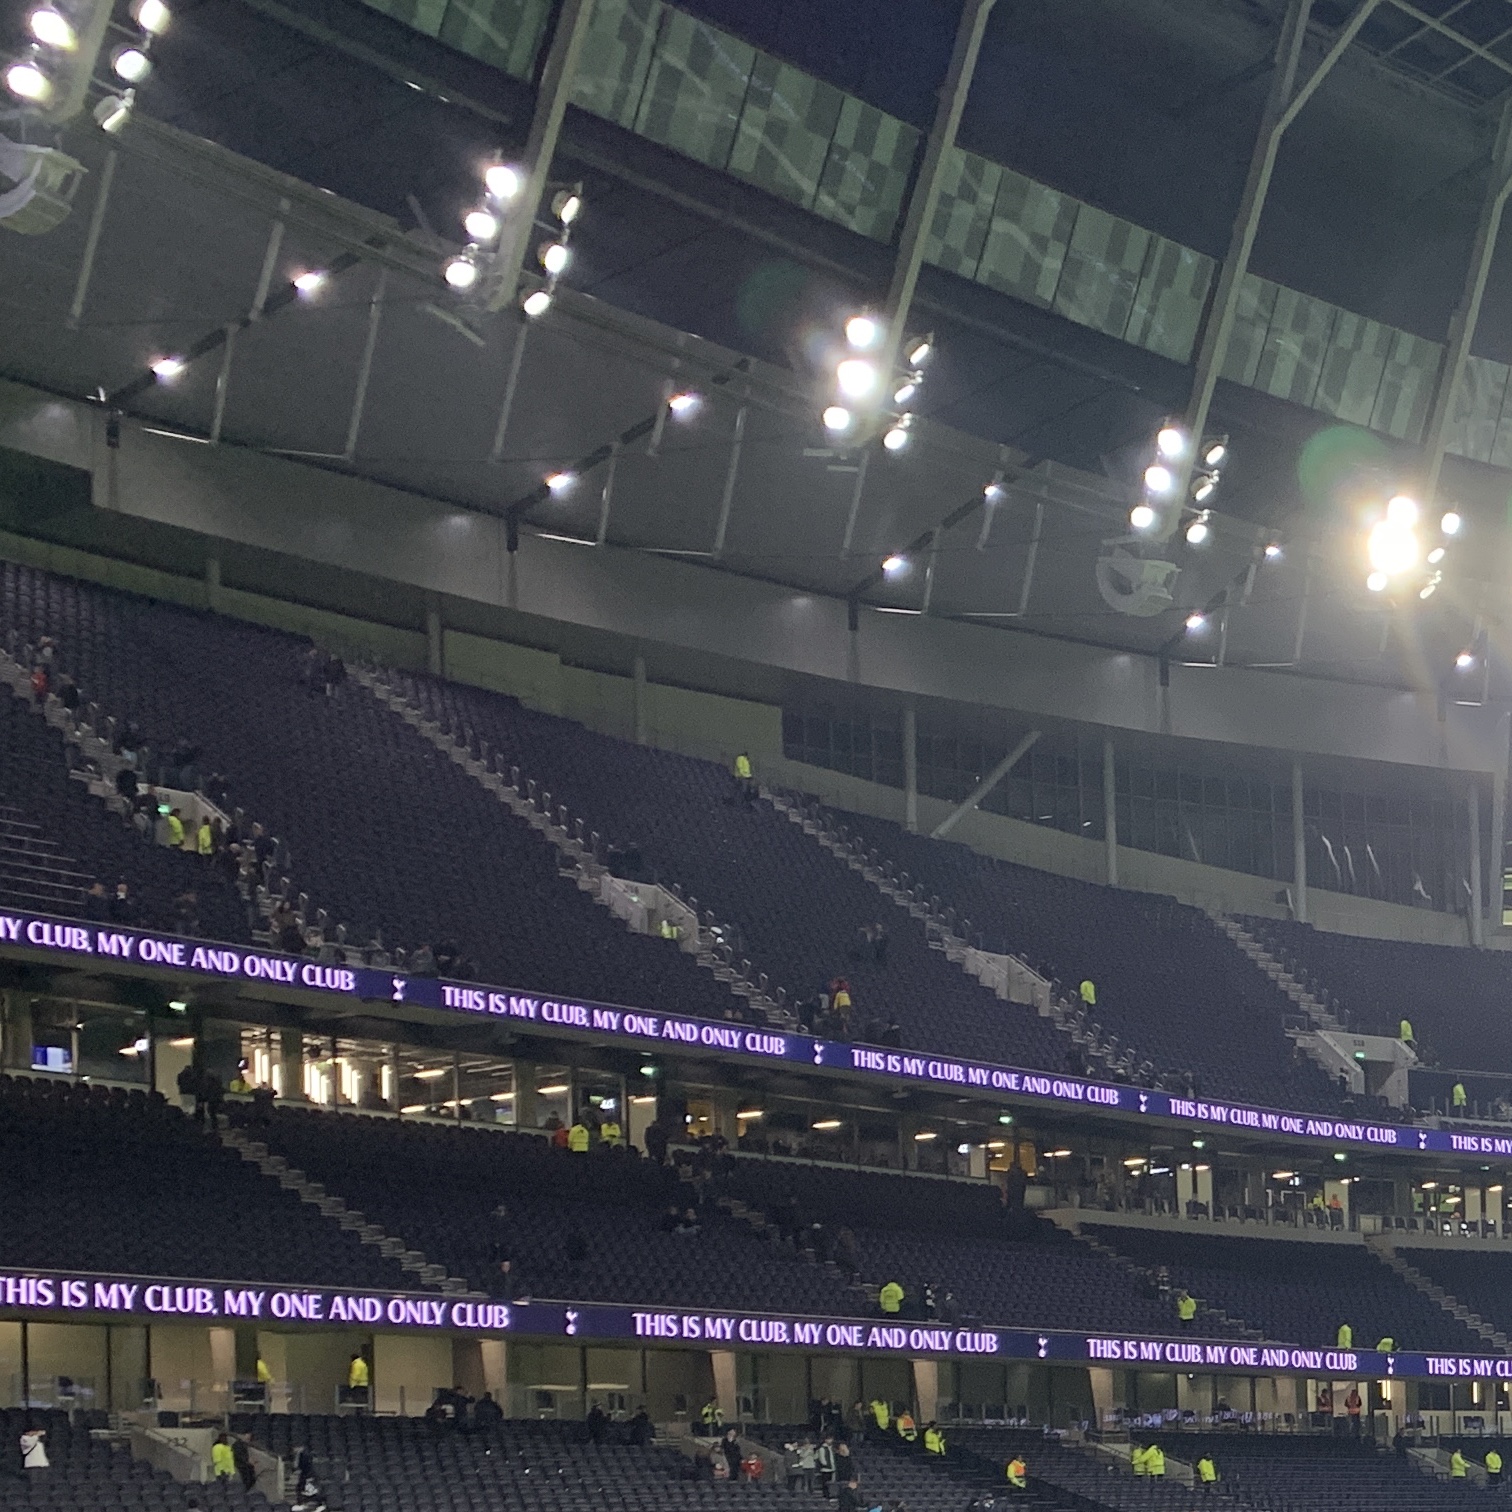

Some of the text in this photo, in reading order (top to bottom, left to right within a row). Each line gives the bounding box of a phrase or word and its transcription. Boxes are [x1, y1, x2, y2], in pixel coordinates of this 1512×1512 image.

[97, 931, 134, 957] MY
[138, 938, 187, 966] ONE
[190, 947, 240, 973] AND
[243, 955, 298, 982] ONLY
[301, 964, 356, 991] CLUB
[441, 986, 486, 1011] THIS
[488, 993, 507, 1014] IS
[509, 996, 538, 1018] MY
[593, 1009, 621, 1030] MY
[623, 1014, 659, 1037] ONE
[662, 1020, 699, 1042] AND
[701, 1026, 742, 1049] ONLY
[745, 1032, 786, 1055] CLUB
[61, 1280, 88, 1308] IS
[94, 1282, 138, 1310] MY
[224, 1289, 265, 1316] MY
[270, 1292, 323, 1319] ONE
[328, 1295, 383, 1322] AND
[387, 1298, 447, 1325] ONLY
[451, 1302, 510, 1329] CLUB
[632, 1312, 679, 1337] THIS
[682, 1315, 701, 1338] IS
[704, 1317, 735, 1340] MY
[794, 1322, 823, 1345] MY
[826, 1324, 864, 1347] ONE
[867, 1326, 907, 1349] AND
[909, 1328, 953, 1351] ONLY
[955, 1331, 998, 1353] CLUB
[1086, 1338, 1121, 1359] THIS
[1123, 1340, 1138, 1360] IS
[1140, 1341, 1163, 1361] MY
[1206, 1345, 1228, 1364] MY
[1230, 1346, 1259, 1366] ONE
[1260, 1348, 1290, 1367] AND
[1291, 1350, 1324, 1369] ONLY
[1325, 1352, 1358, 1371] CLUB
[1426, 1357, 1457, 1375] THIS
[1458, 1358, 1472, 1376] IS
[1473, 1359, 1494, 1376] MY
